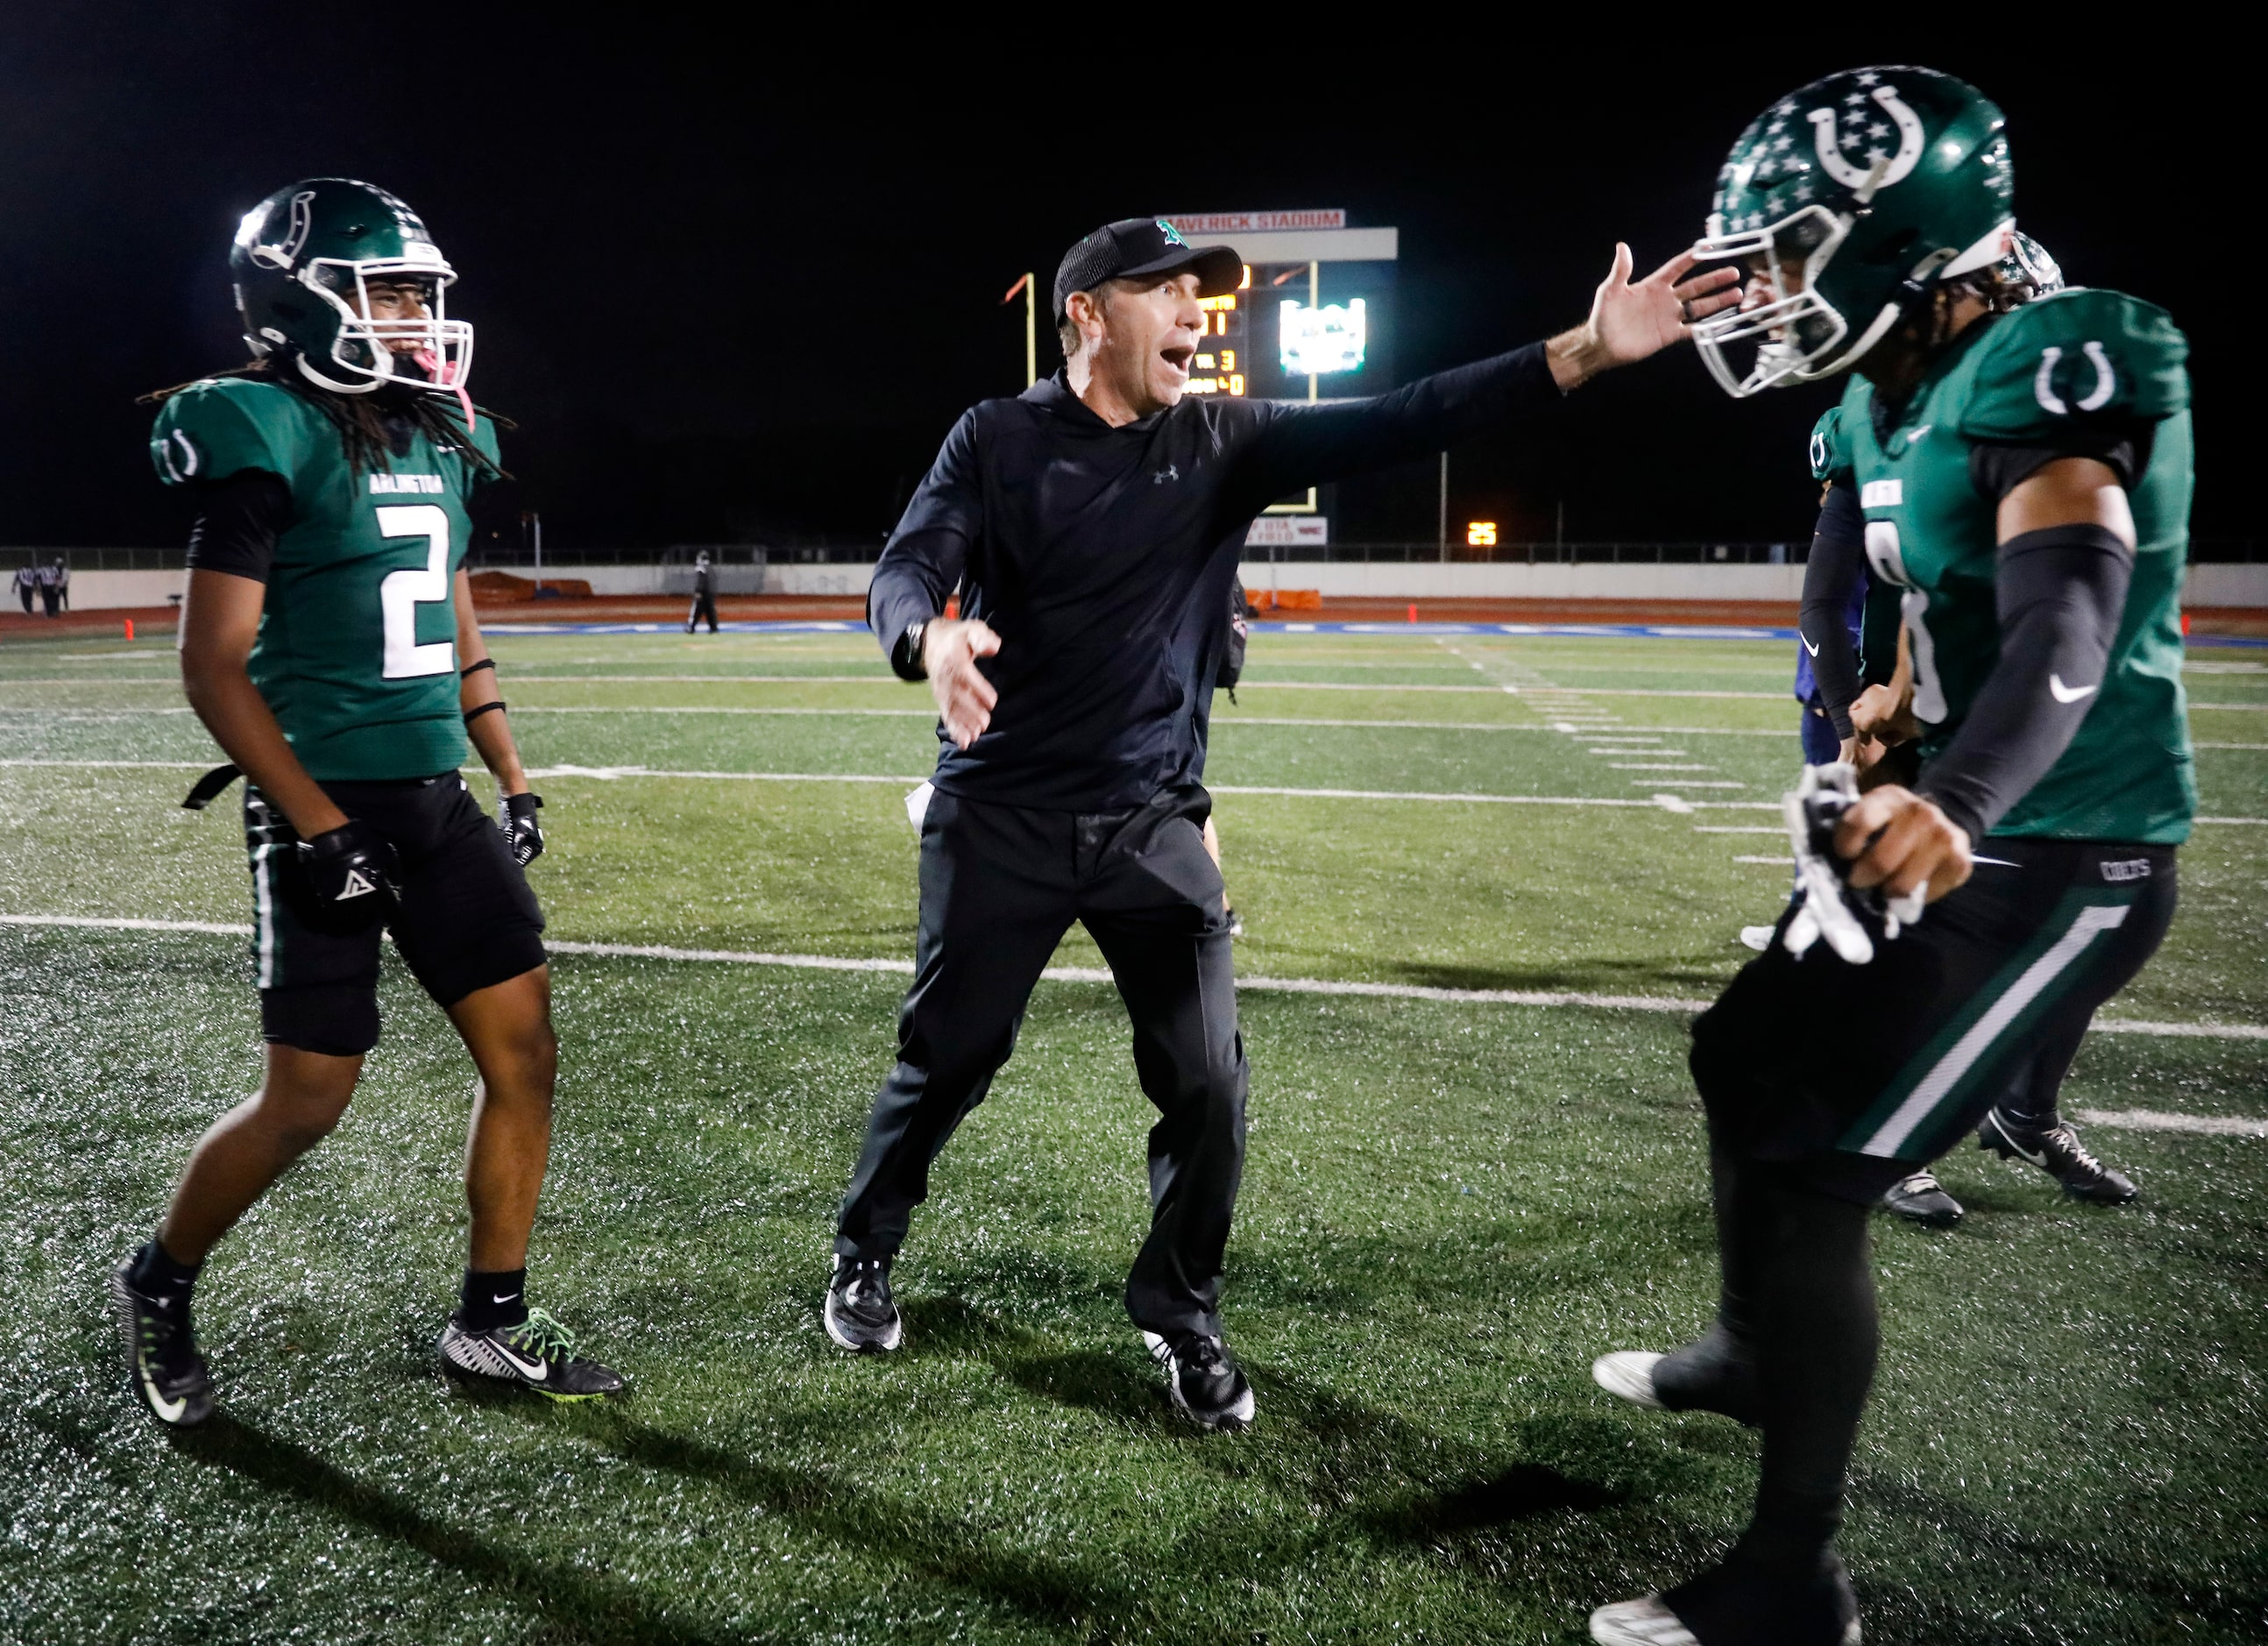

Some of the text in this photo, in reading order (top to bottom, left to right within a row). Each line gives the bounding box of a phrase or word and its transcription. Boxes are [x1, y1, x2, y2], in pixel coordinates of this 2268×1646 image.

[1257, 210, 1341, 228] STADIUM
[1221, 350, 1235, 372] 3
[375, 504, 454, 678] 2
